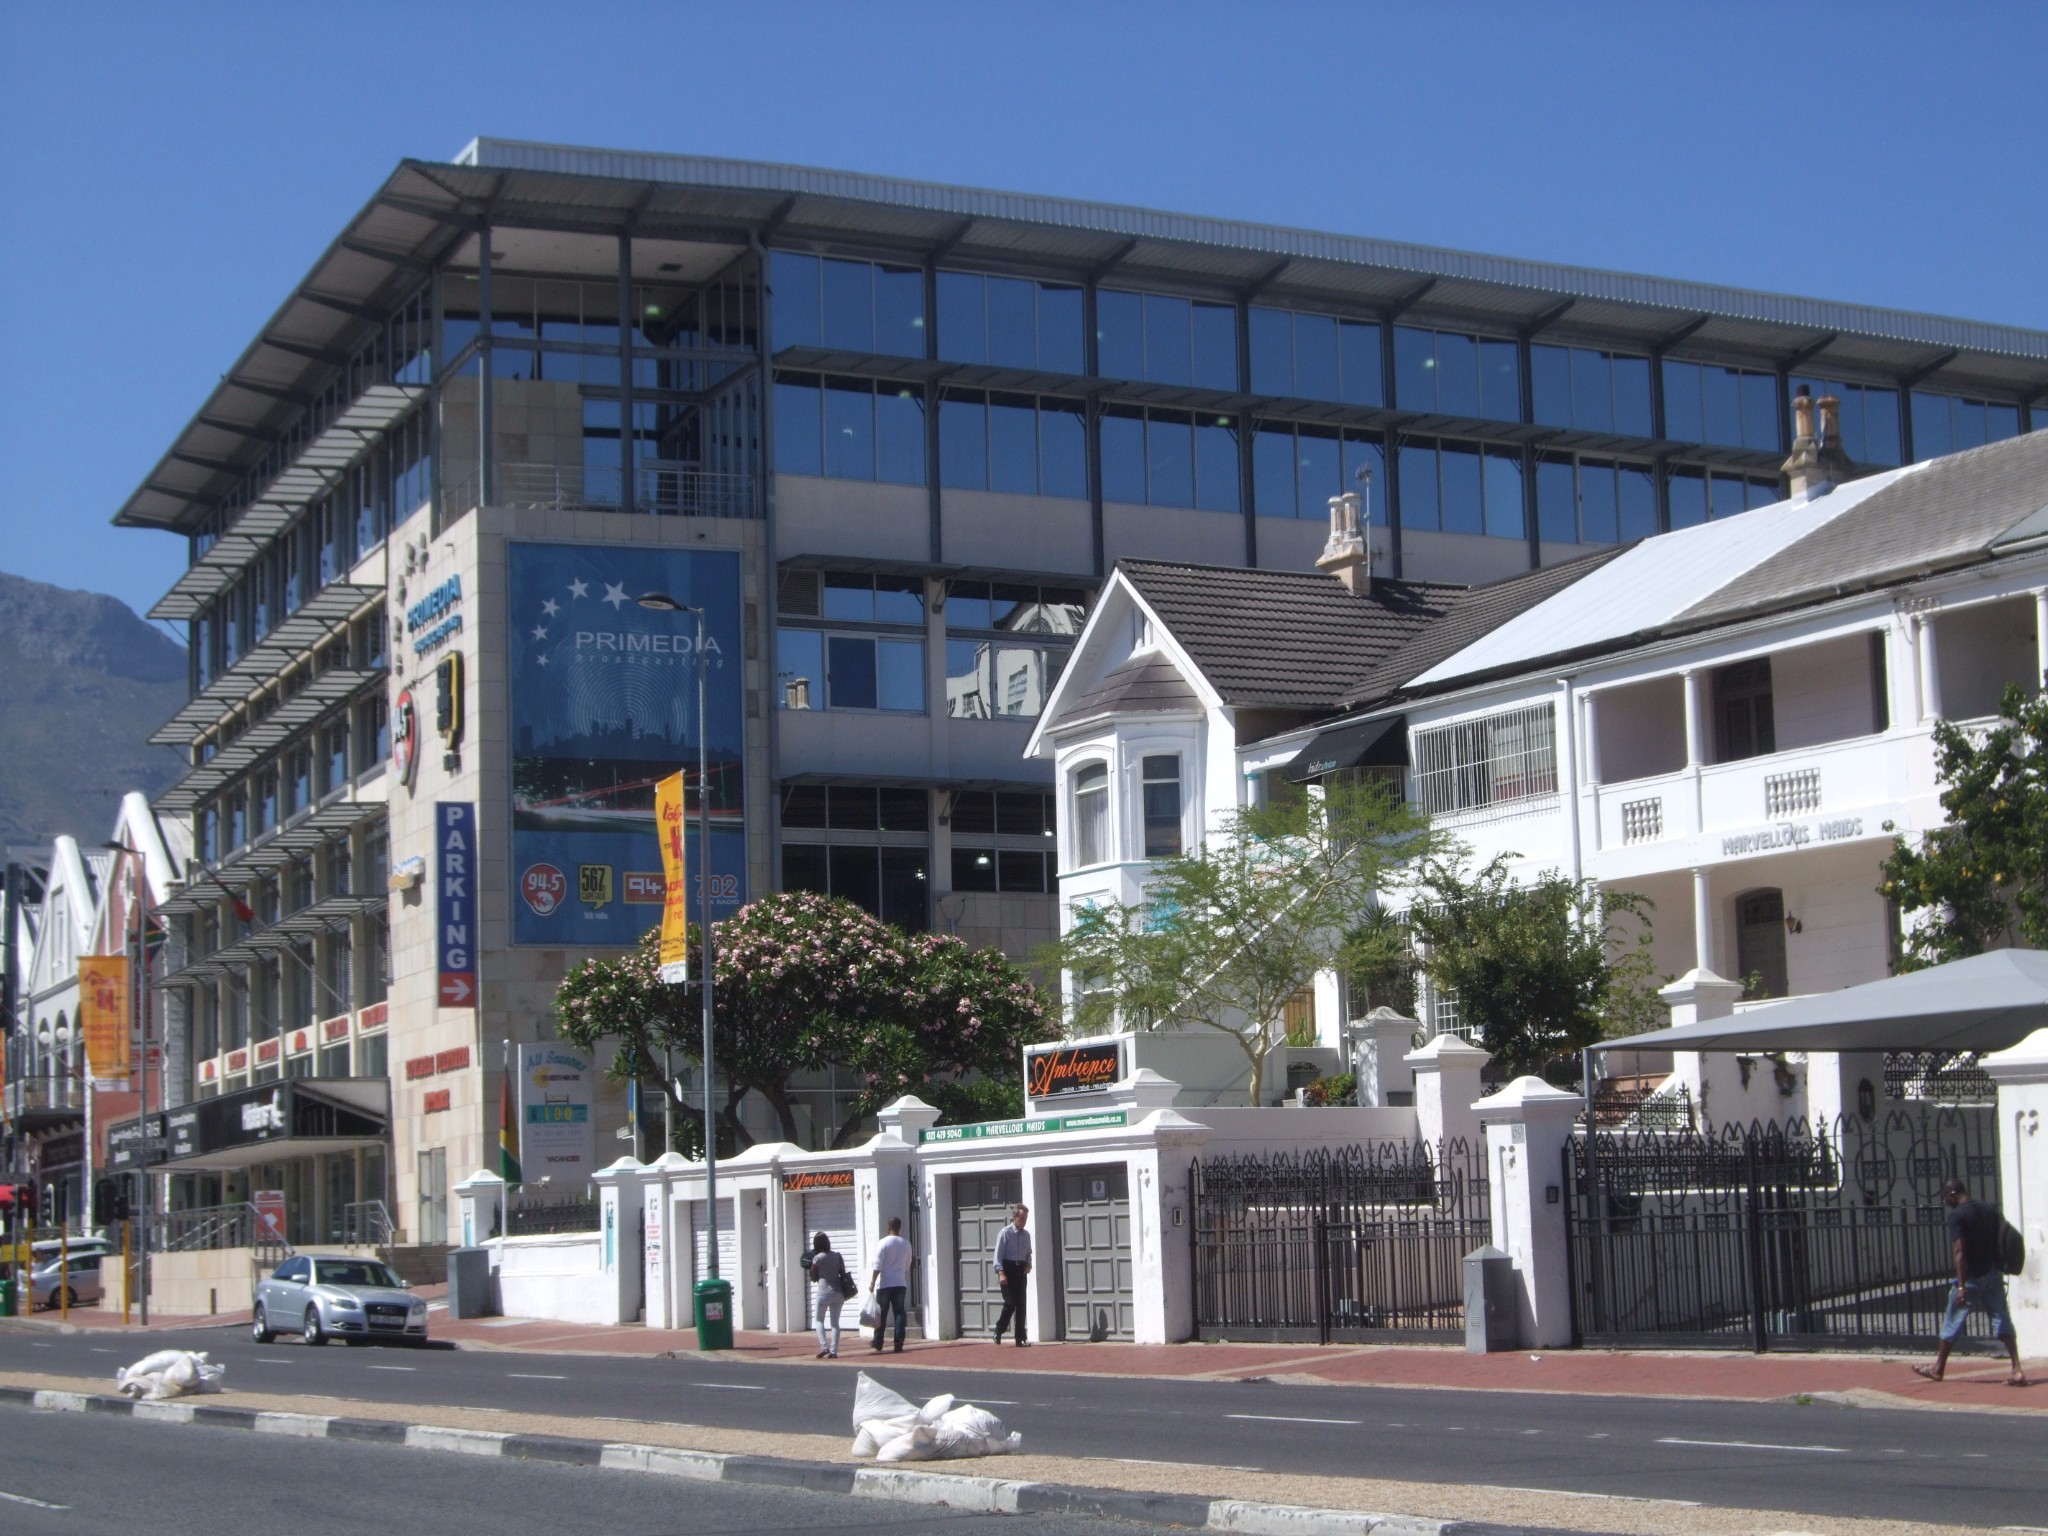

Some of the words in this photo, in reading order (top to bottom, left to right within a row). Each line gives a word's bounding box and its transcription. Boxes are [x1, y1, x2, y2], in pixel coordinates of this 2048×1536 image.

[575, 631, 722, 654] PRIMEDIA
[576, 653, 724, 669] broadcasting
[1721, 825, 1810, 856] MARVELLOUS
[1818, 817, 1863, 840] MAIDS
[445, 806, 468, 970] PARKING
[527, 873, 563, 891] 94.5
[581, 867, 605, 892] 567
[628, 877, 666, 895] 94.
[526, 1052, 543, 1072] All
[546, 1049, 588, 1072] Seasons
[1028, 1048, 1117, 1098] Ambience
[544, 1106, 573, 1121] 100
[926, 1130, 936, 1141] 021
[936, 1130, 946, 1140] 419
[947, 1128, 962, 1139] 5040
[986, 1122, 1023, 1136] MARVELLOUS
[1026, 1120, 1046, 1132] MAIDS
[784, 1171, 853, 1191] Ambience
